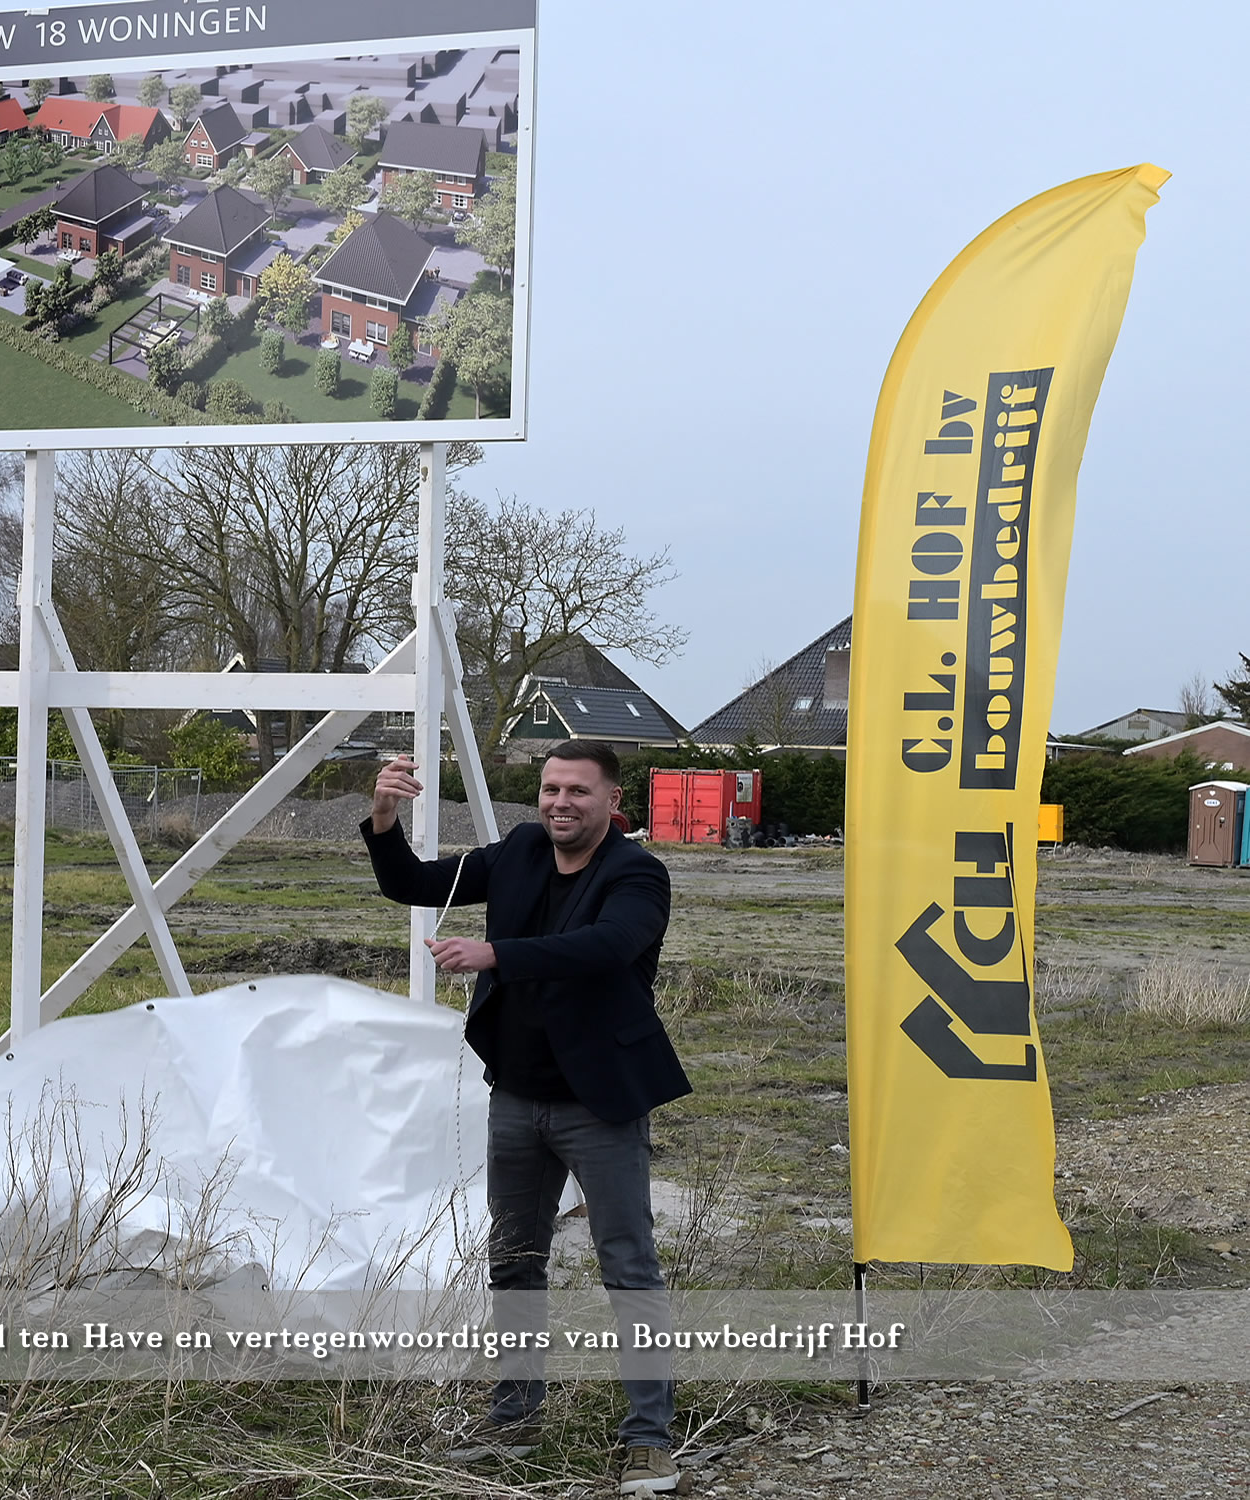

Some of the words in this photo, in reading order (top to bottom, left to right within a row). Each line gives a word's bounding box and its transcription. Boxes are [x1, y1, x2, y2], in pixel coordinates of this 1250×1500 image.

[35, 20, 67, 48] 18
[78, 5, 267, 43] WONINGEN
[923, 388, 979, 456] bv
[907, 491, 967, 621] HOF
[974, 383, 1039, 771] bouwbedrijf
[901, 649, 957, 774] C.L.
